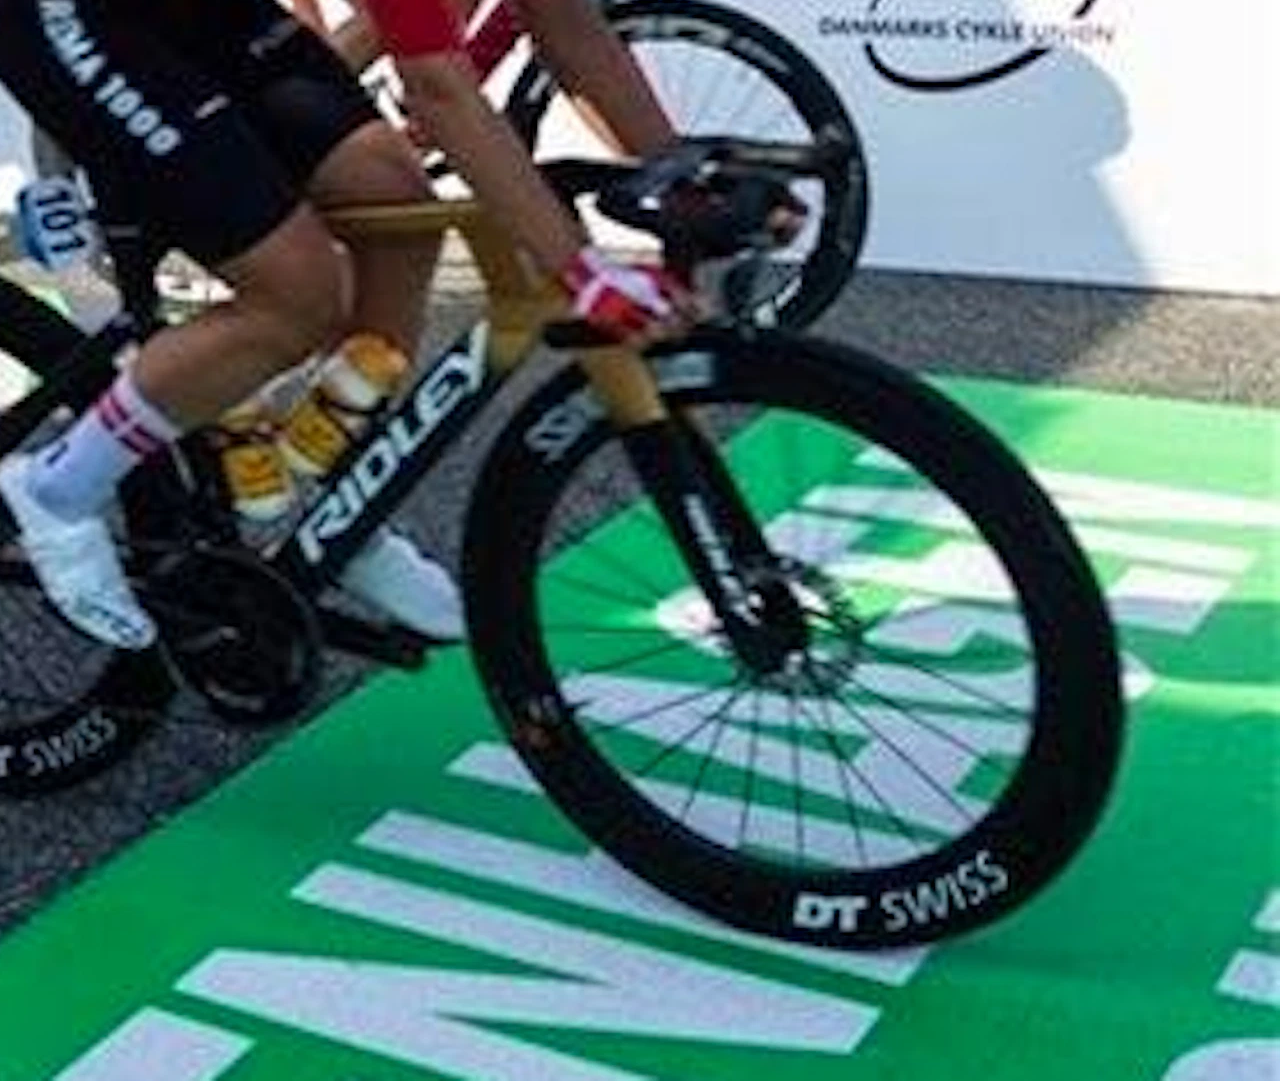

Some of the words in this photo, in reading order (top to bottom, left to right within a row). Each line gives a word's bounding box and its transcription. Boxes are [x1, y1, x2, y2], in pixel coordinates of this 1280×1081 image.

[818, 16, 948, 39] DANMARKS
[953, 18, 1024, 42] CYKLE
[93, 72, 182, 156] 1000
[36, 189, 87, 255] 101
[297, 320, 490, 562] RIDLEY
[22, 707, 117, 776] SWISS
[793, 890, 870, 933] DT
[880, 849, 1009, 932] SWISS
